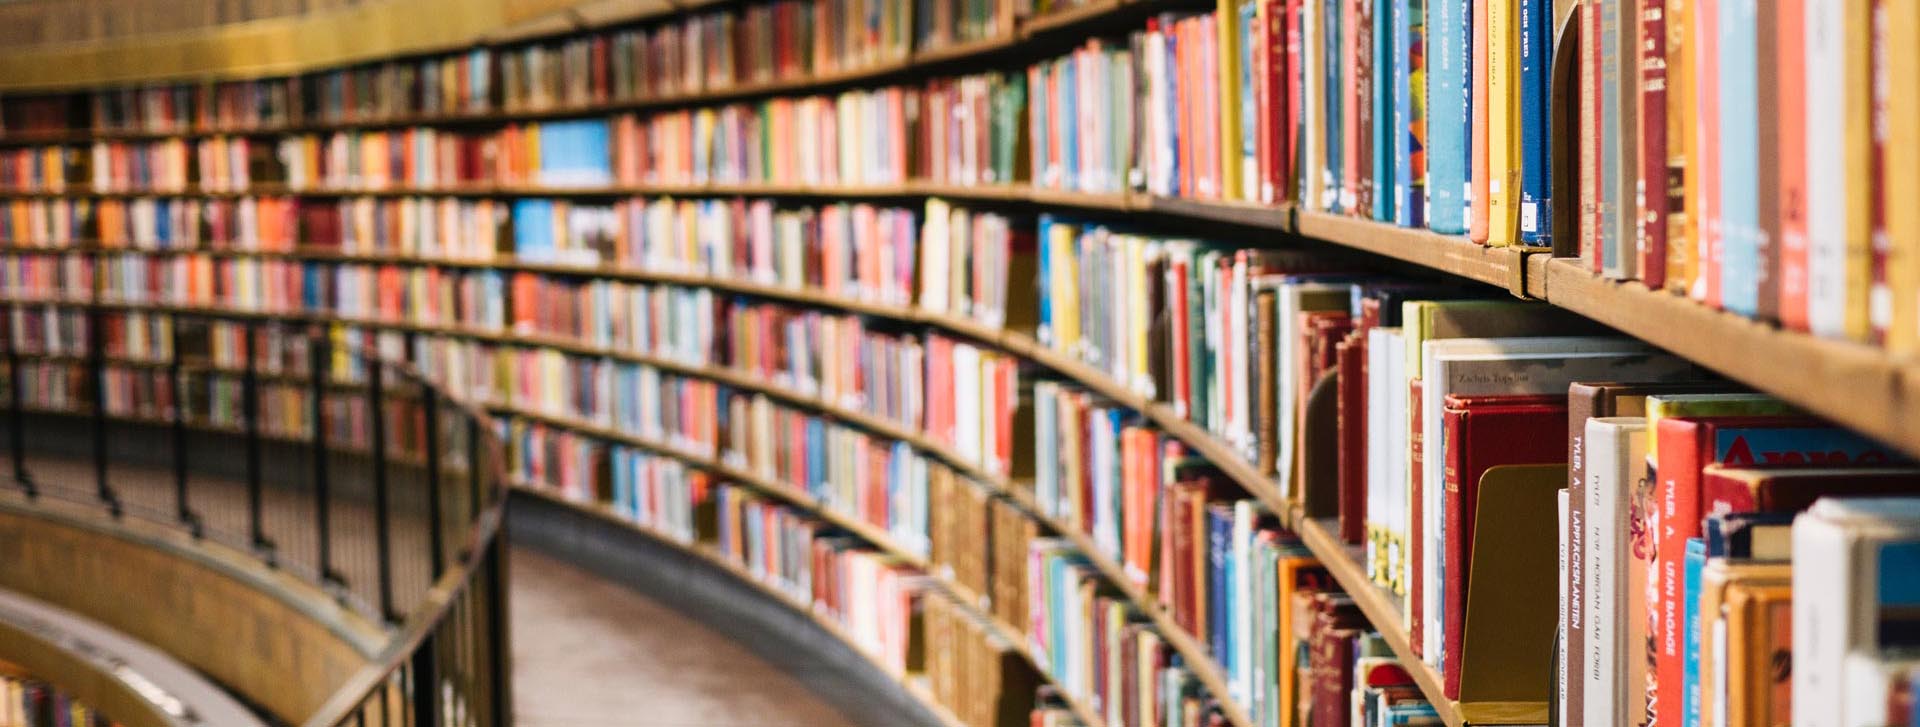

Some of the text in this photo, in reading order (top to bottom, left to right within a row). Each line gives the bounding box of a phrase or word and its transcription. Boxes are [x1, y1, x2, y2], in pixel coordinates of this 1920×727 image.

[1573, 436, 1581, 472] TYLER,
[1665, 561, 1675, 596] UTAN
[1665, 601, 1676, 657] BAGAGE
